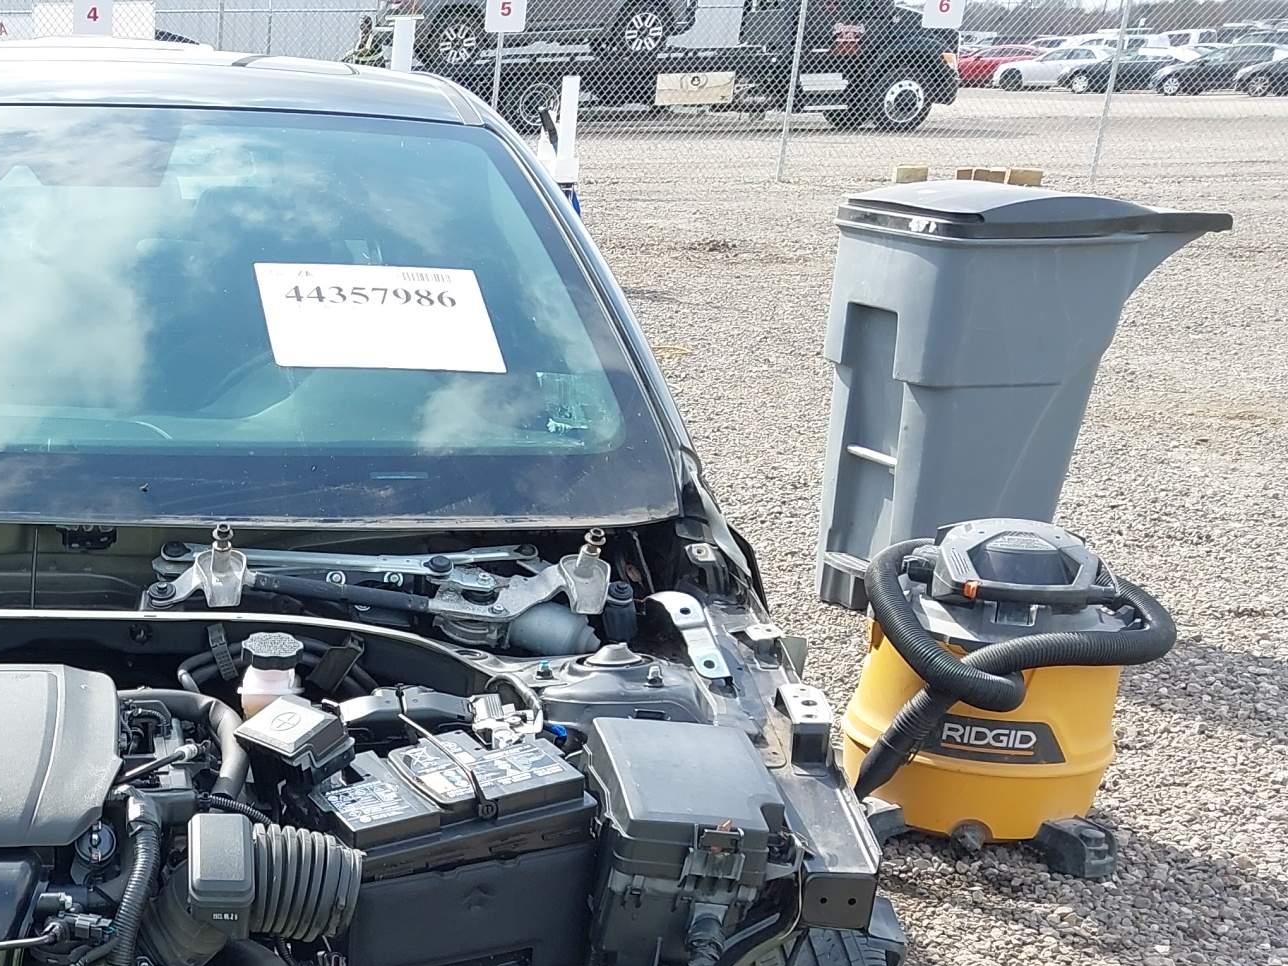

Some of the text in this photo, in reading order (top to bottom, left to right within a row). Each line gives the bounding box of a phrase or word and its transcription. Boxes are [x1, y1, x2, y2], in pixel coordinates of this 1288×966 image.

[86, 6, 99, 22] 4
[500, 1, 512, 17] 5
[939, 0, 951, 13] 6
[284, 285, 457, 309] 44357986
[941, 722, 1037, 749] RIDGID
